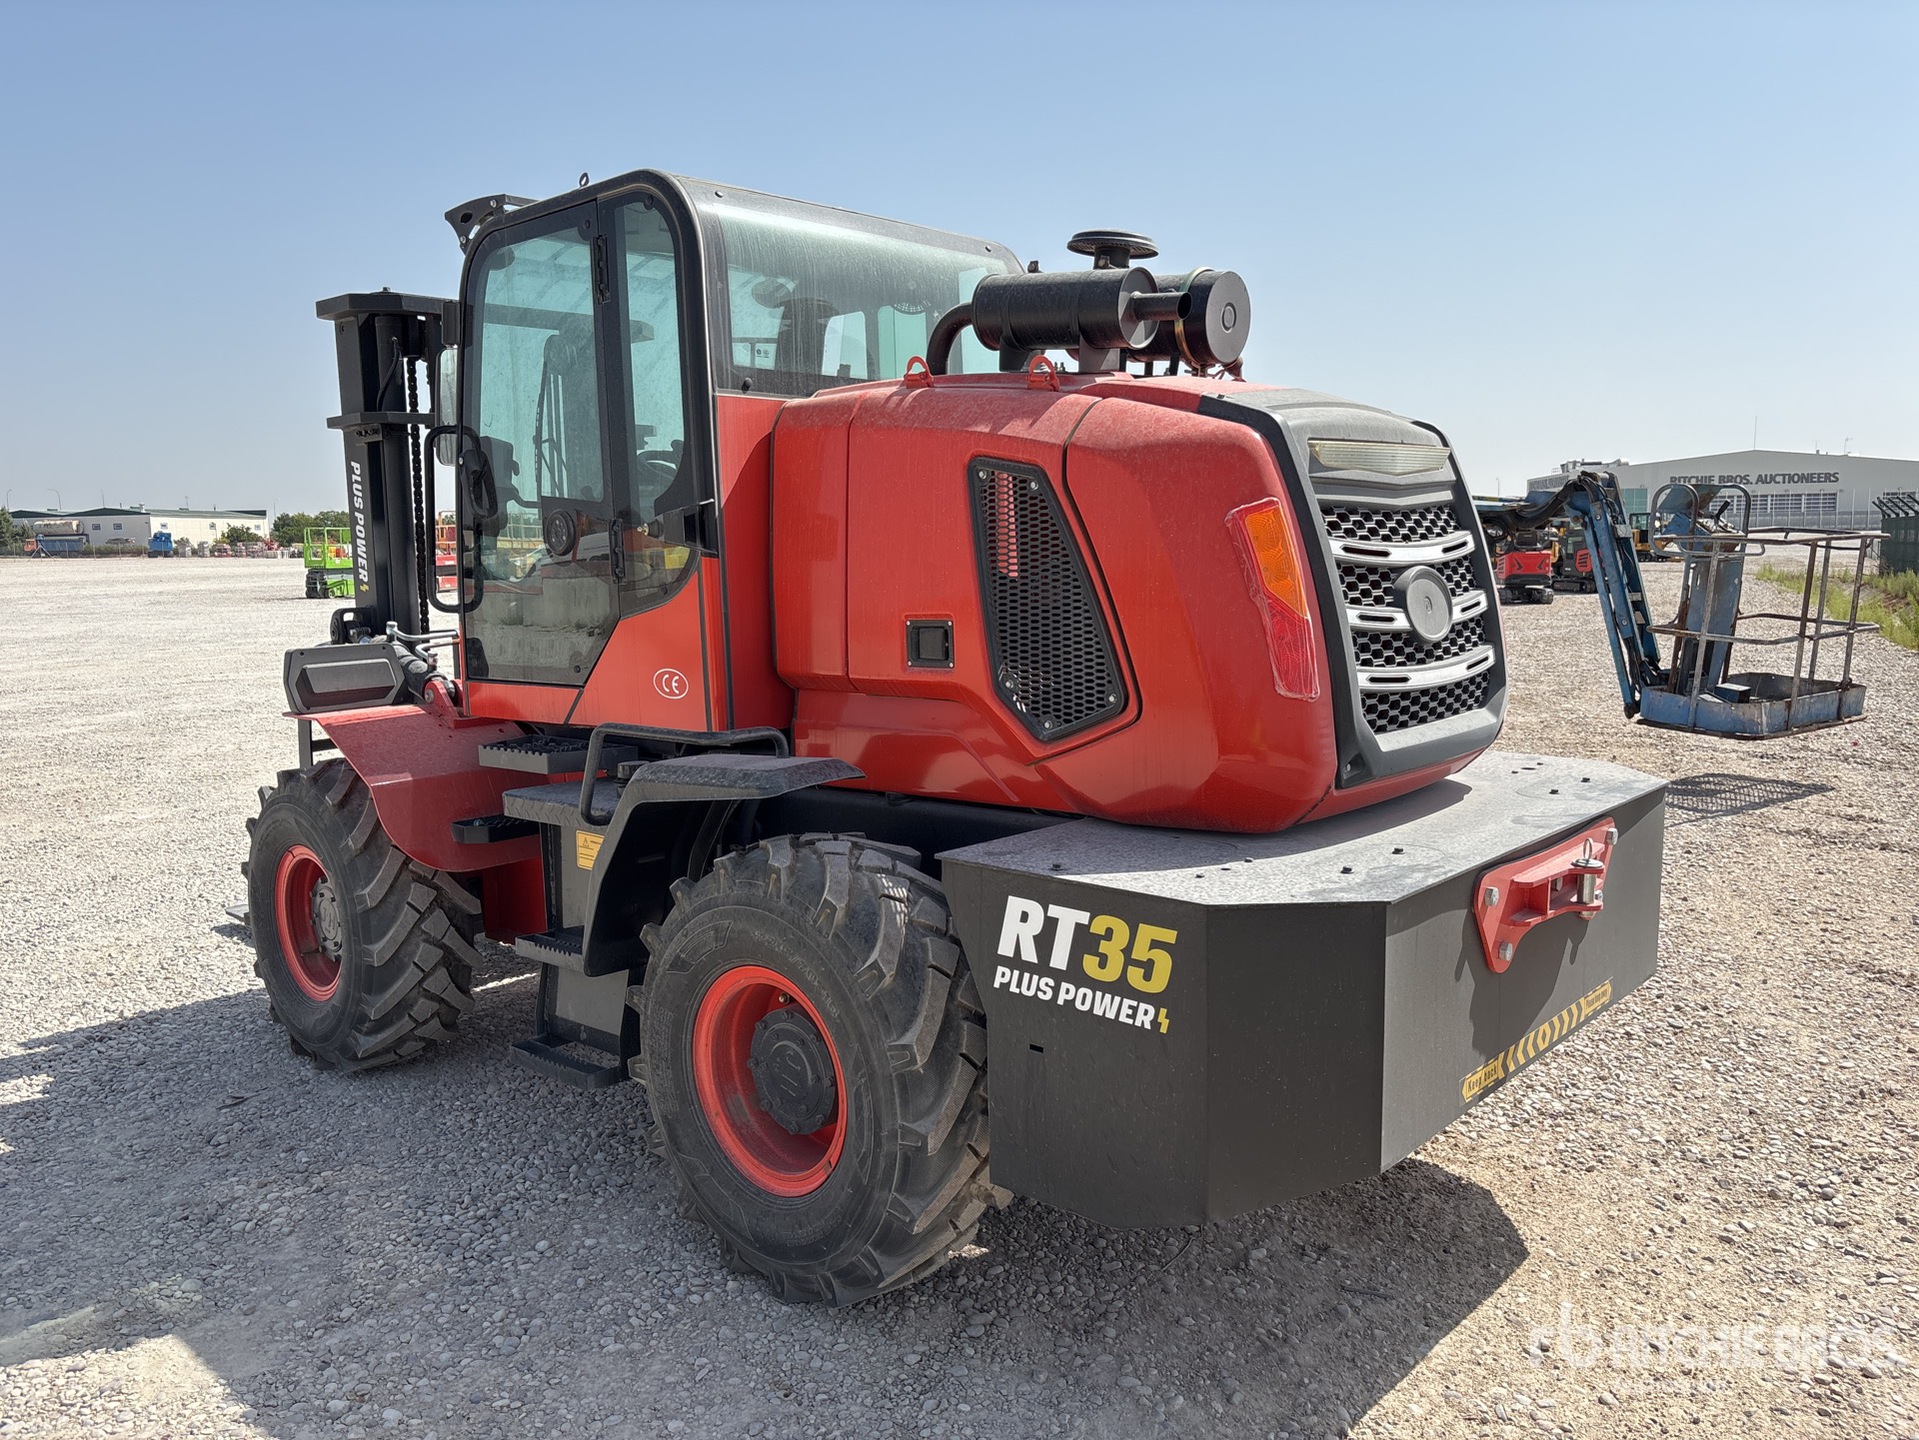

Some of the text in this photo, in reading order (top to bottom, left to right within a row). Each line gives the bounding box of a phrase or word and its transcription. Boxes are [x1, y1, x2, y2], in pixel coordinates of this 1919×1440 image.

[1669, 475, 1715, 485] RITCHIE
[1755, 472, 1839, 485] AUCTIONEERS
[350, 461, 370, 583] PLUS POWER
[997, 895, 1178, 994] RT35
[993, 965, 1156, 1030] PLUS POWER
